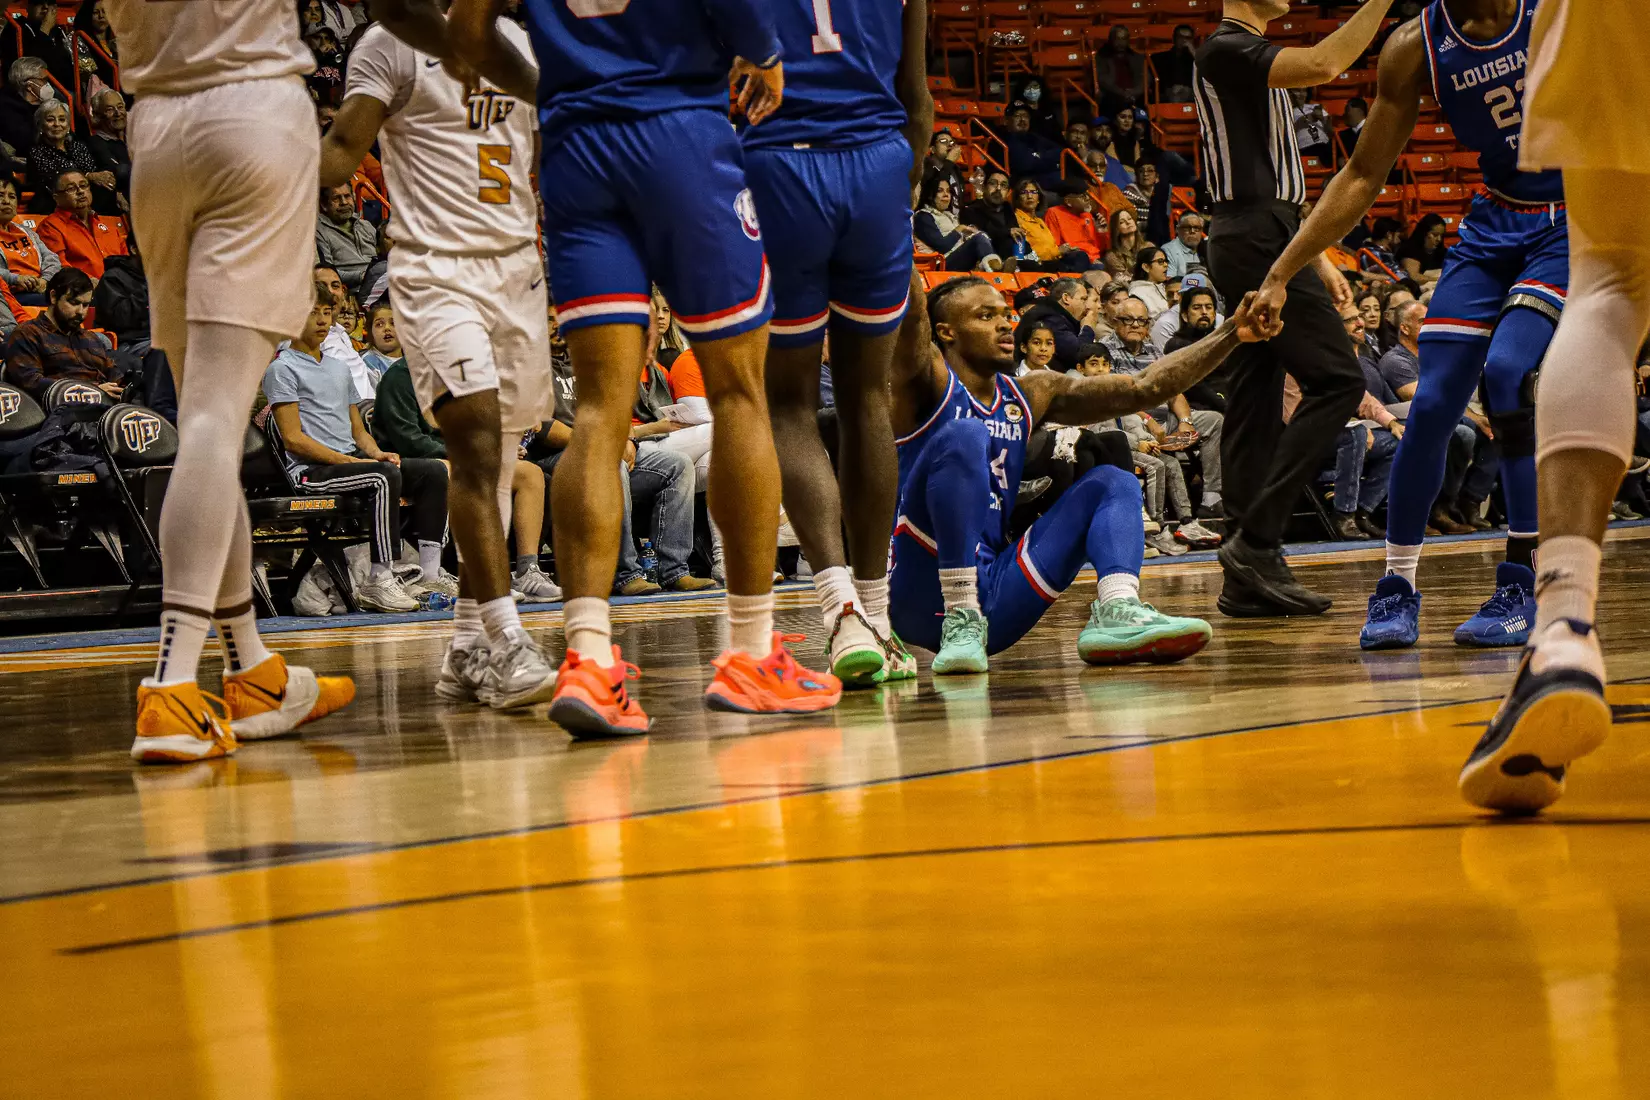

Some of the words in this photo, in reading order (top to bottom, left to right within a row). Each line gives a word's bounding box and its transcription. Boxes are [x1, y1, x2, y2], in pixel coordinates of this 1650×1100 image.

[1450, 48, 1530, 92] LOUISIA
[477, 143, 512, 205] 5
[120, 411, 161, 453] UTEP
[57, 473, 98, 485] MINER
[290, 499, 336, 510] MINERS
